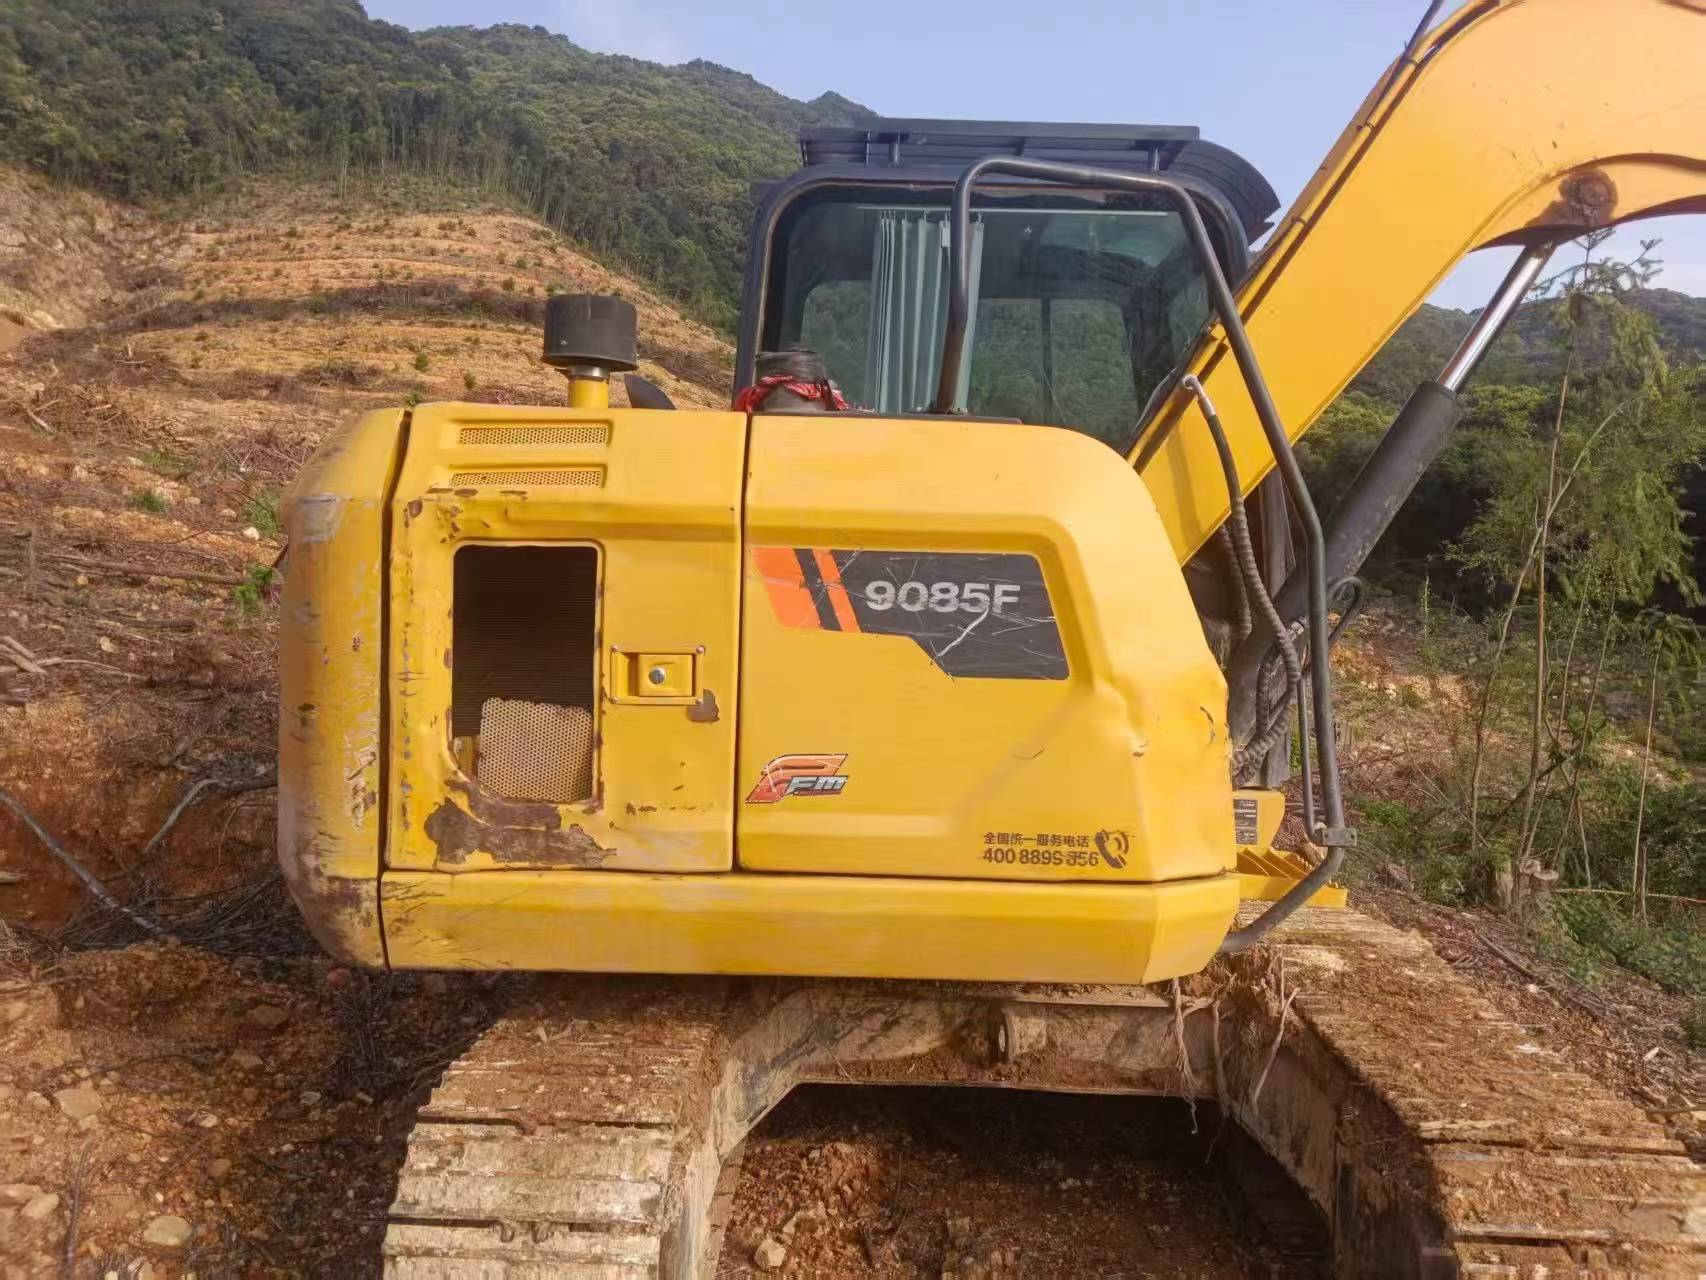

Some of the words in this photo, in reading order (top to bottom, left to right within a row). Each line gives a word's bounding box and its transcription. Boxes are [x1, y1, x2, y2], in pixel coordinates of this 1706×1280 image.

[865, 580, 1021, 613] 9085F
[983, 832, 1089, 847] 全国统一服务电话
